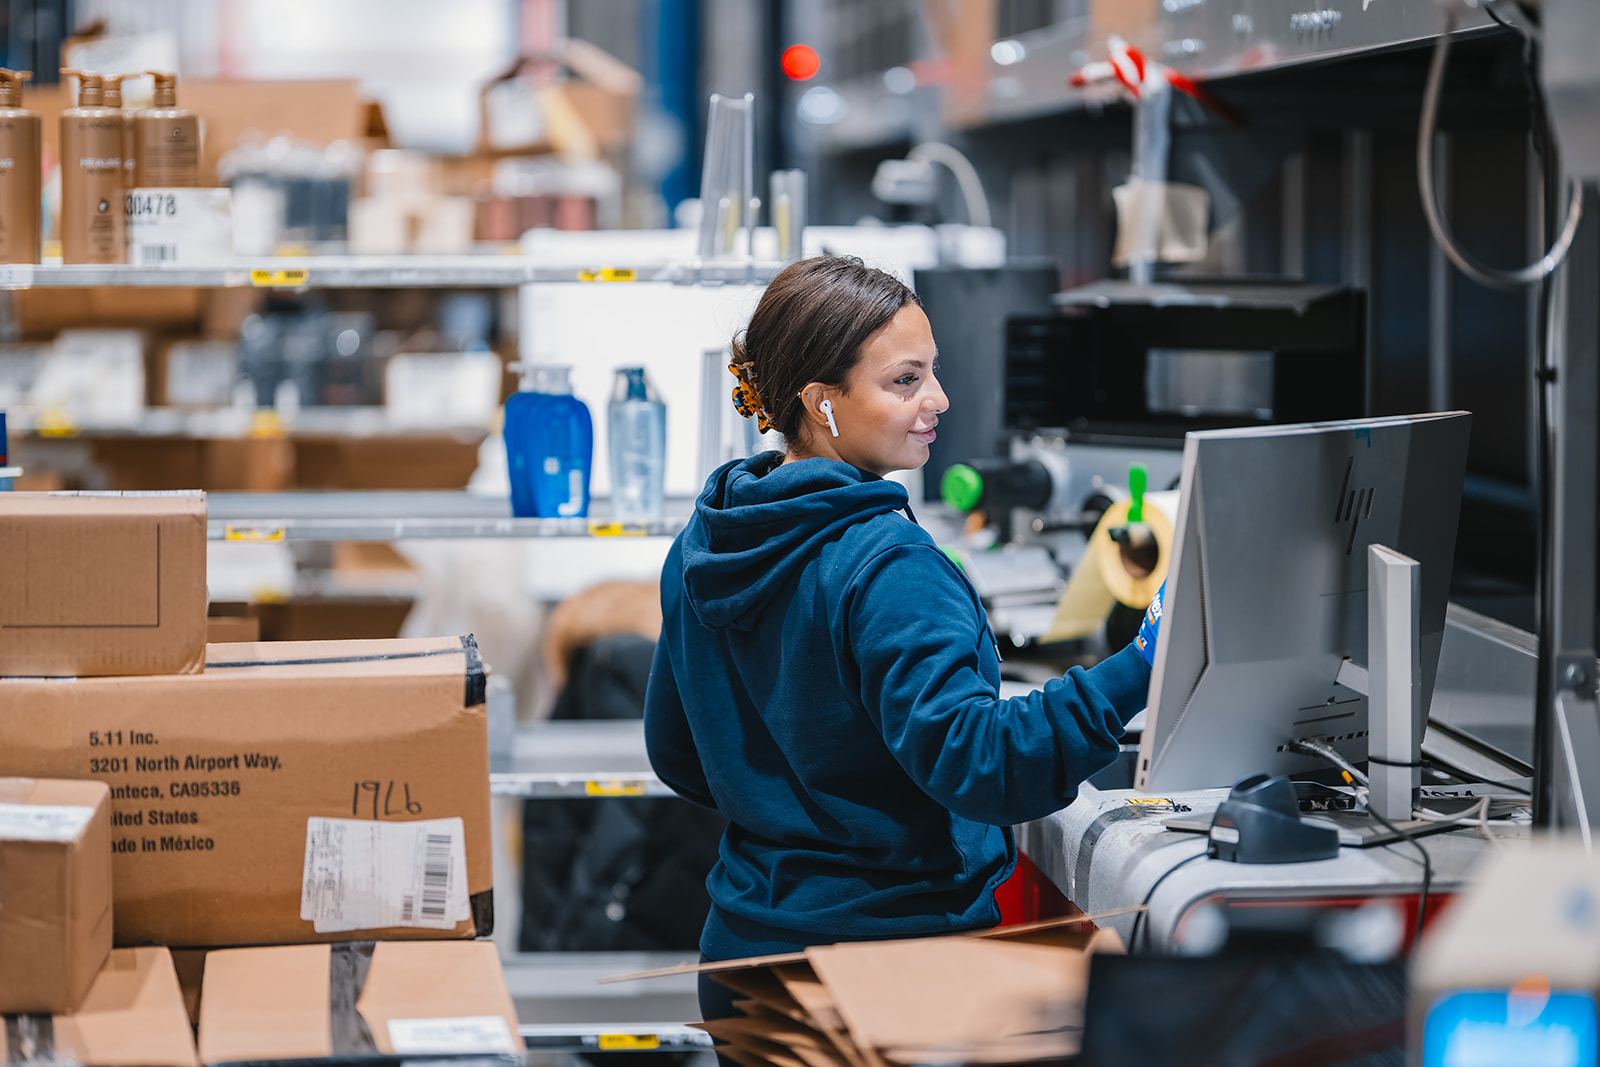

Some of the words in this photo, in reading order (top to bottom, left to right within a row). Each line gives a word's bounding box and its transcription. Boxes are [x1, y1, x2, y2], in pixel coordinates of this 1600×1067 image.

[89, 731, 122, 746] 5.11
[129, 731, 159, 745] Inc.
[90, 758, 128, 773] 3201
[135, 756, 179, 772] North
[184, 755, 239, 772] Airport
[170, 781, 241, 798] CA95336
[148, 810, 198, 825] States
[141, 837, 156, 853] in
[160, 835, 214, 851] México
